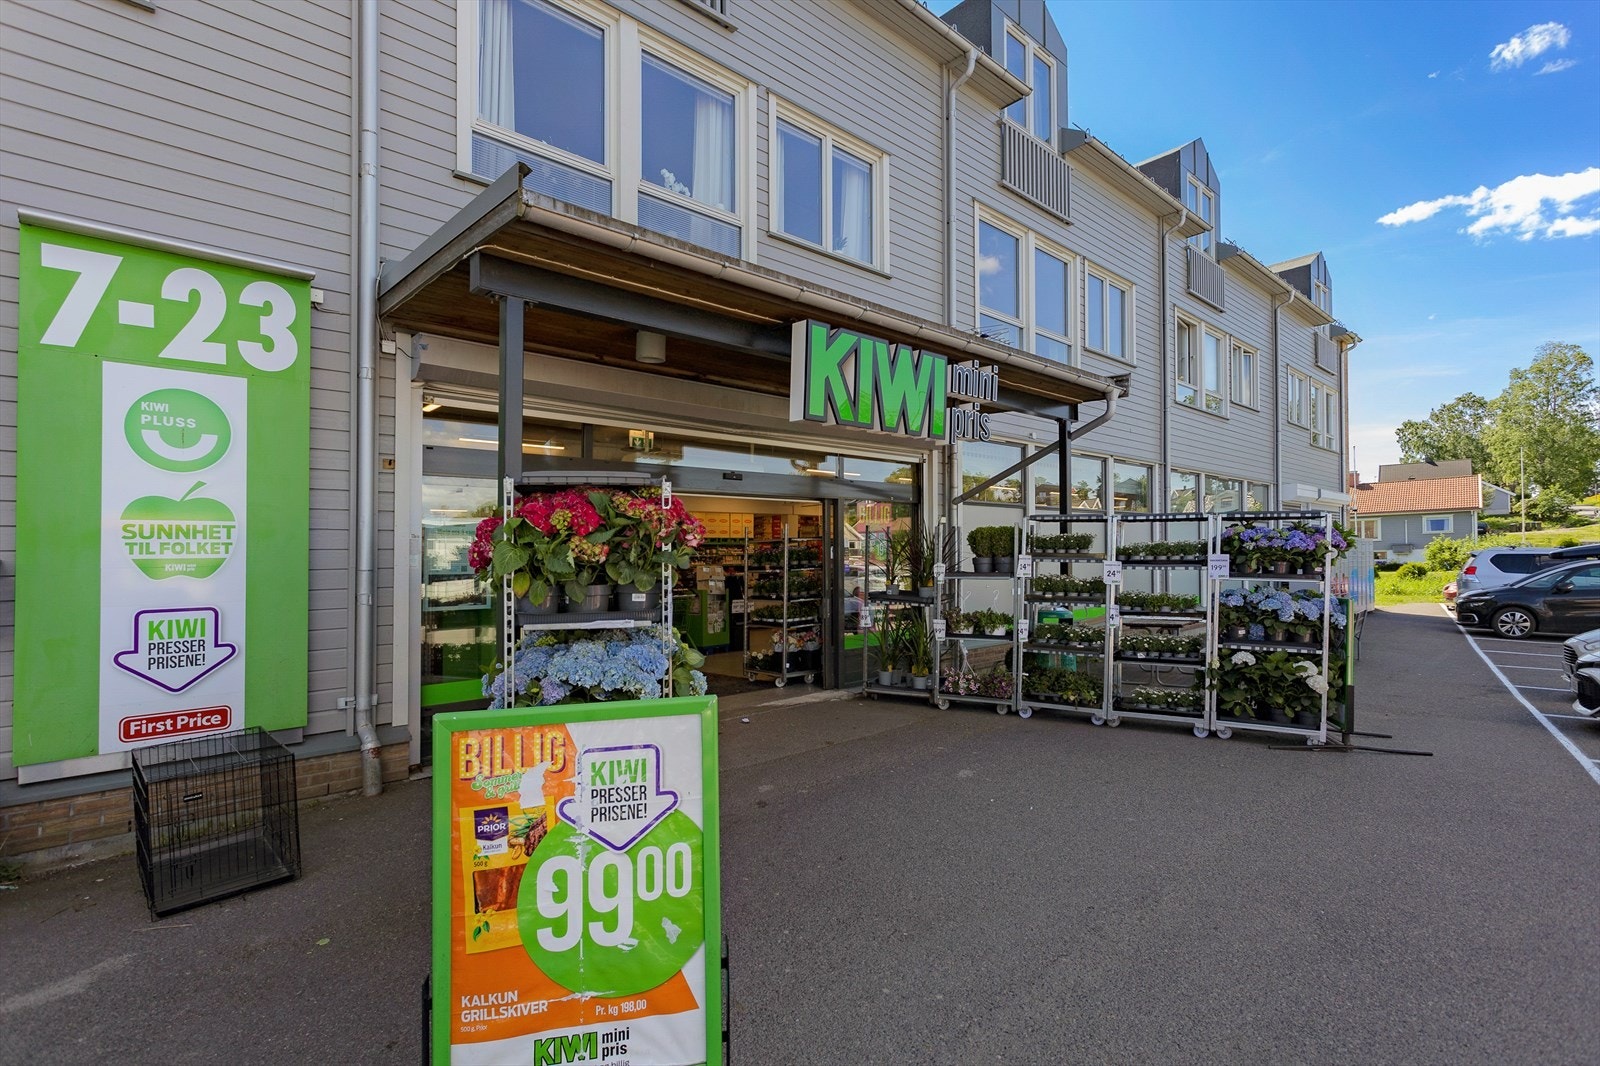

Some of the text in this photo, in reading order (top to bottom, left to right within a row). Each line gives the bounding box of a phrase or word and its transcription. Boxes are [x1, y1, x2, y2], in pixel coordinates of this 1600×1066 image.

[39, 242, 298, 372] 7-23
[804, 318, 948, 440] KIWI
[951, 359, 999, 402] mini
[140, 401, 169, 413] KIWI
[140, 414, 197, 429] PLUSS
[951, 402, 992, 444] pris
[121, 523, 236, 540] SUNNHET
[124, 541, 233, 556] TIL FOLKET
[164, 563, 187, 572] KIWI
[147, 618, 207, 641] KIWI
[147, 639, 206, 656] PRESSER
[147, 655, 206, 670] PRISENE!
[129, 712, 222, 736] First Price
[459, 731, 566, 781] BILLIG
[591, 758, 647, 787] KIWI
[591, 784, 647, 805] PRESSER
[591, 803, 647, 823] PRISENE!
[477, 823, 506, 833] PRIOR
[461, 990, 518, 1008] KALKUN
[595, 999, 647, 1016] Pr. kg 198,00
[461, 1000, 548, 1023] GRILLSKIVER
[601, 1026, 630, 1044] mini
[533, 1031, 598, 1066] KIWI
[601, 1043, 628, 1061] pris
